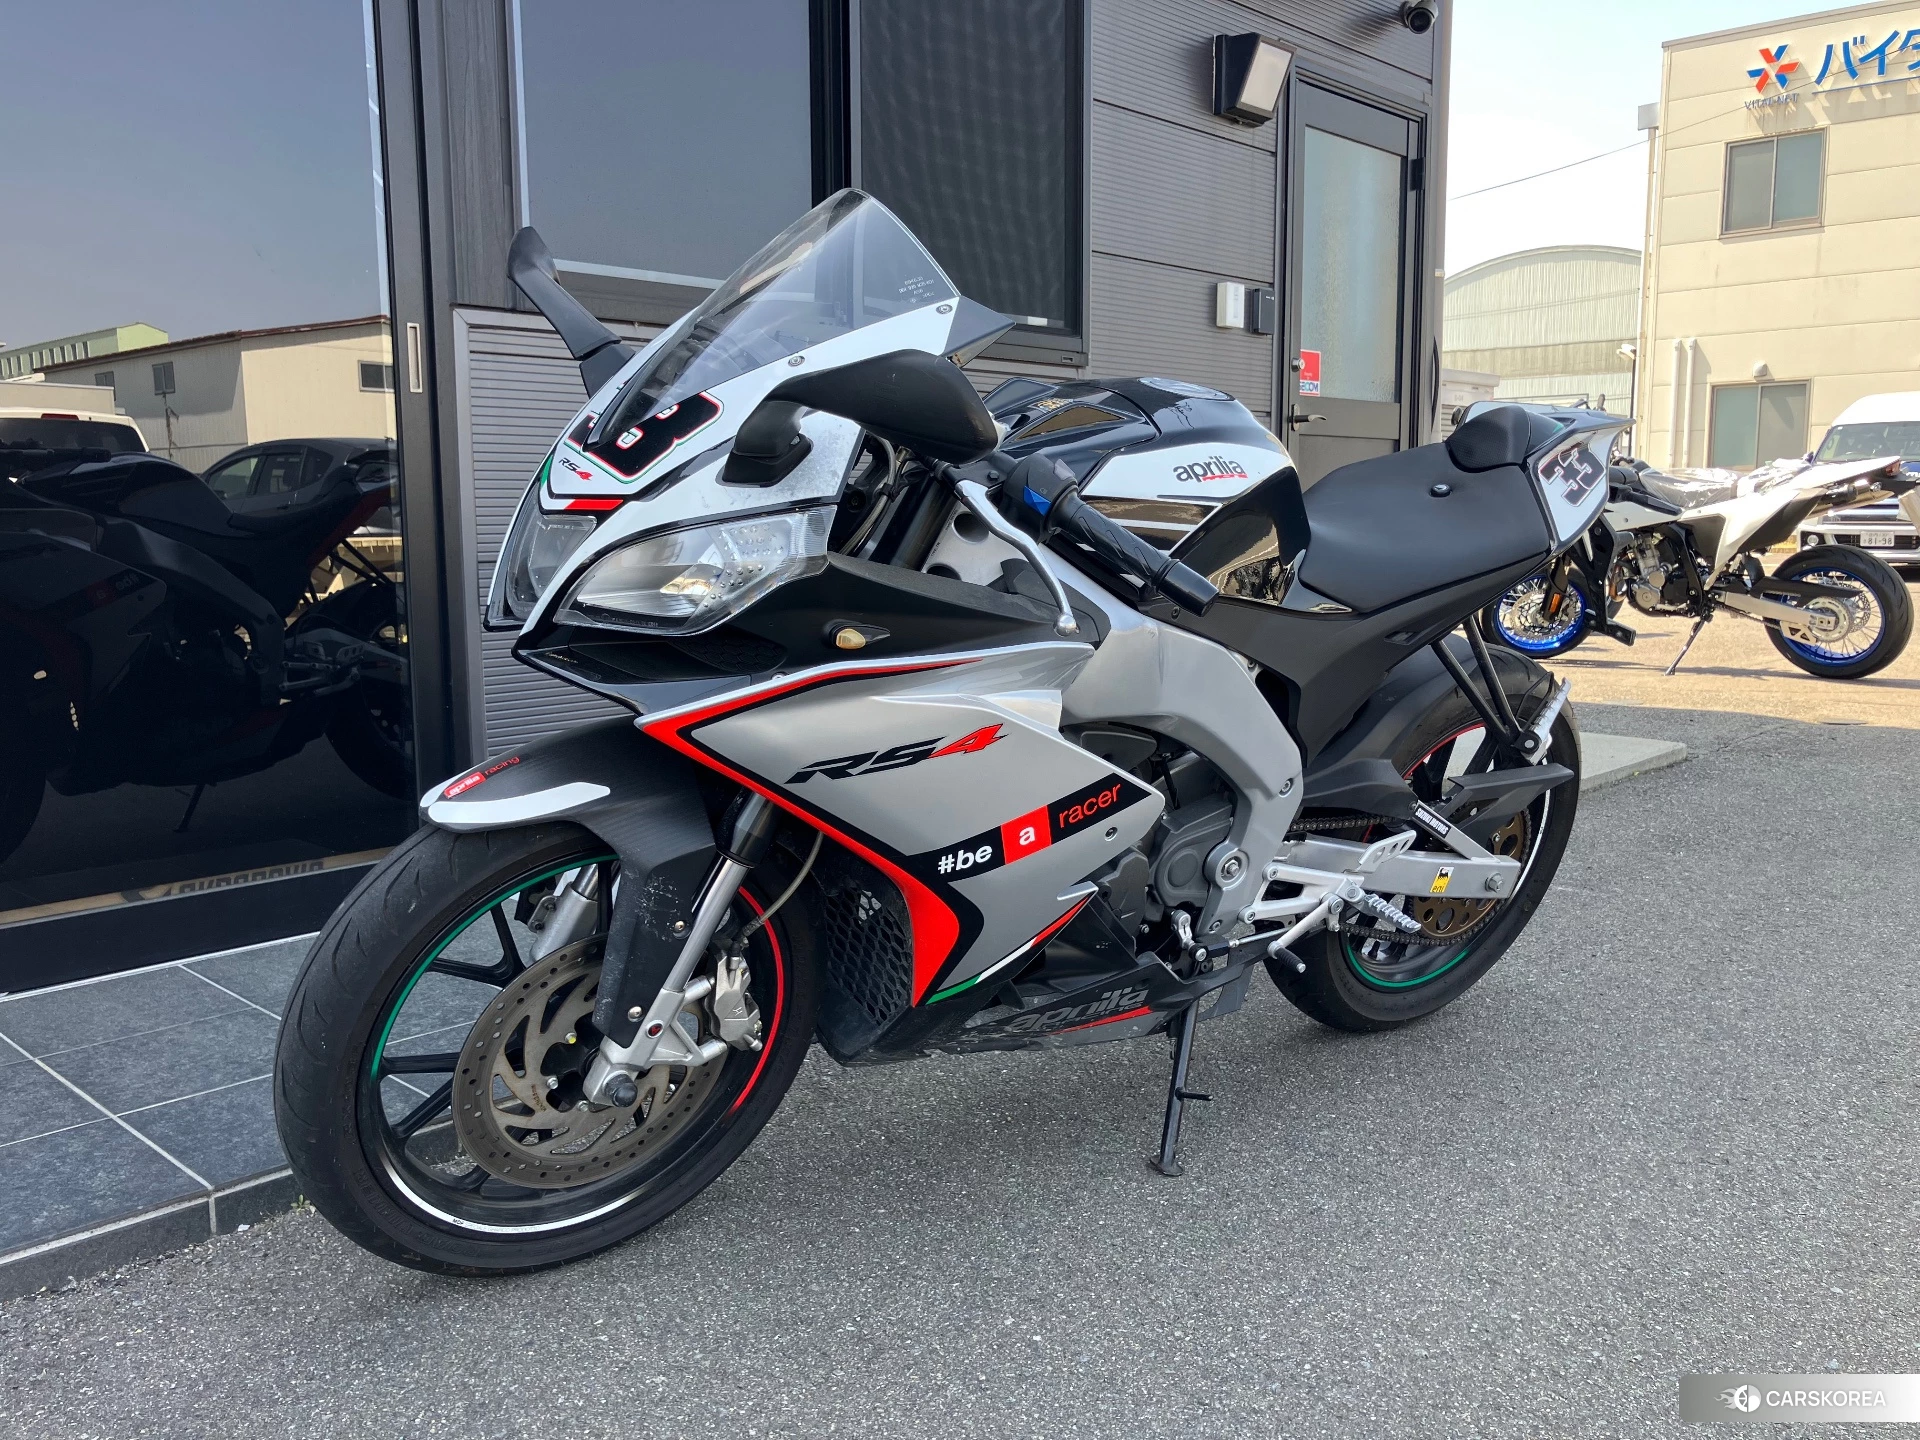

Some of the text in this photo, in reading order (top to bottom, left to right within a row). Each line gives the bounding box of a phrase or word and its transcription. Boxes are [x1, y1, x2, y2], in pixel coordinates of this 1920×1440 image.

[558, 457, 594, 481] RS4
[1172, 455, 1246, 483] aprilia
[783, 723, 1009, 784] RS4
[449, 756, 520, 796] aprilia racing
[937, 783, 1121, 875] #be a racer
